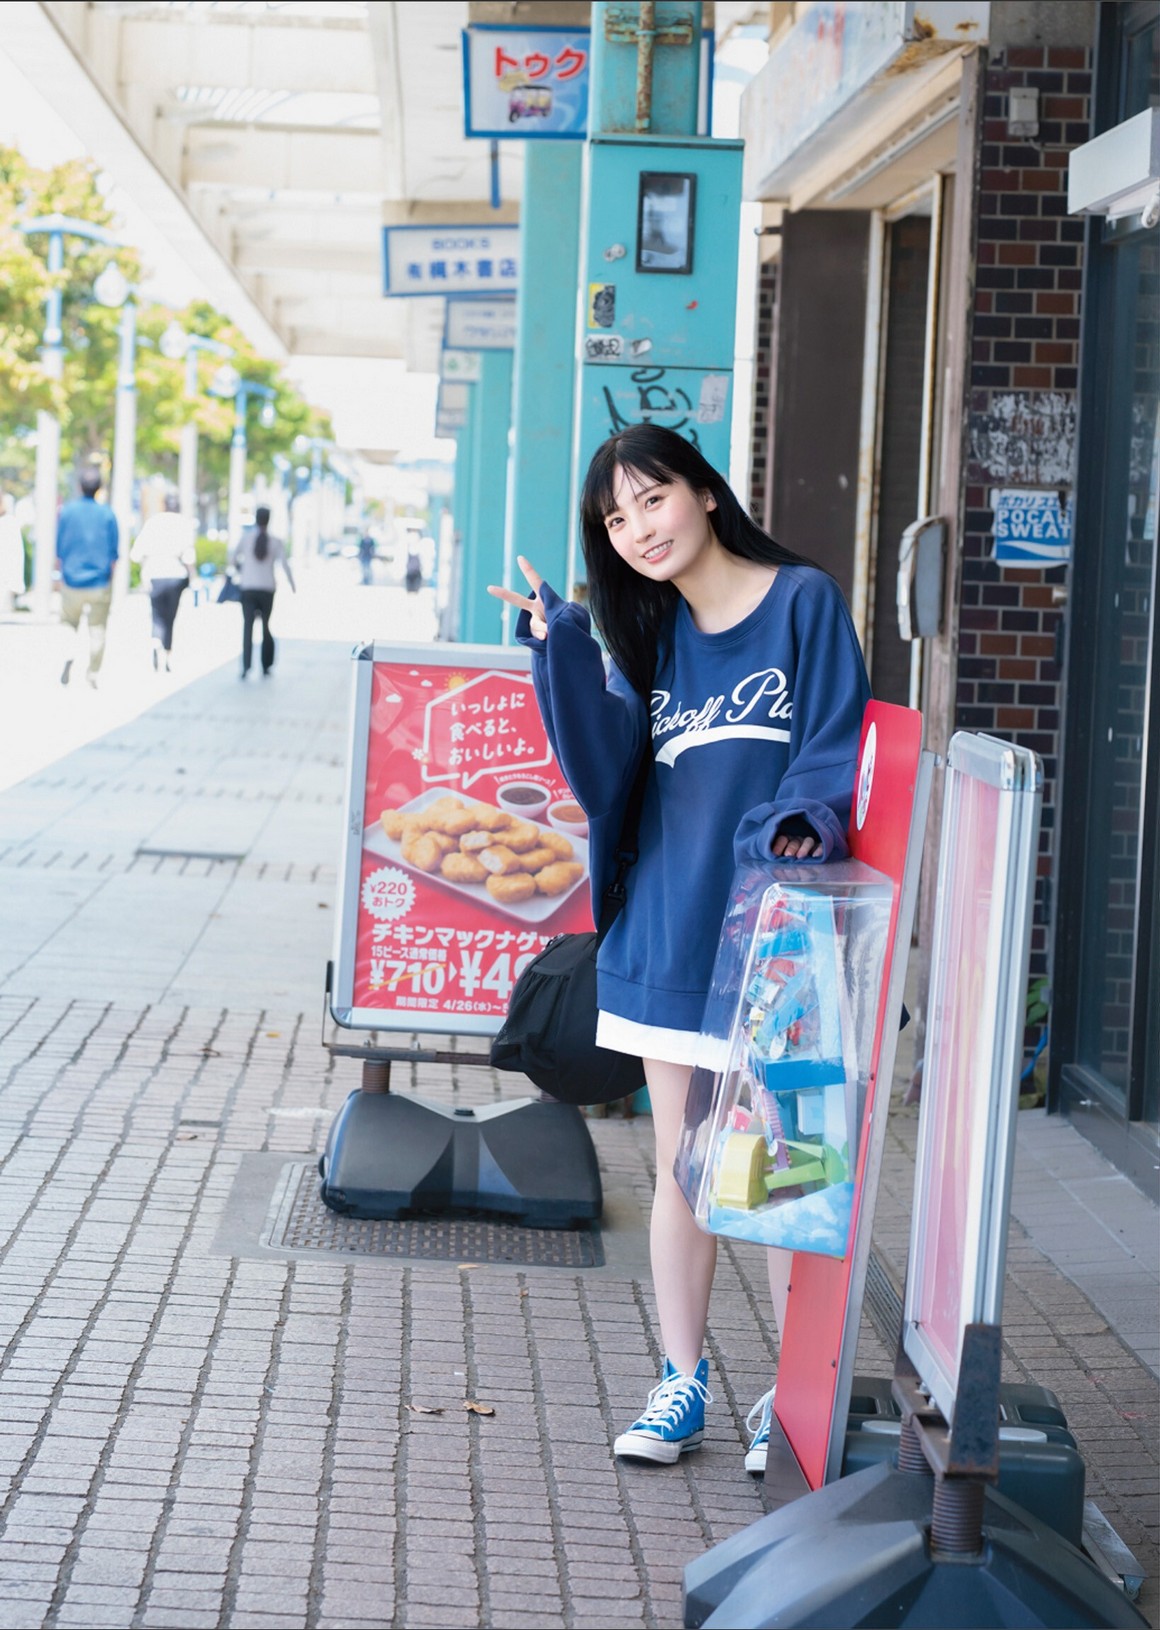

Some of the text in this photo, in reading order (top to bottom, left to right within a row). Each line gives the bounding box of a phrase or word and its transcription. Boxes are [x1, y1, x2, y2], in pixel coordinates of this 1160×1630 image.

[495, 46, 586, 79] トゥク
[997, 522, 1071, 538] SWEAT
[450, 692, 526, 717] いっしょに
[449, 717, 517, 743] 食べると、
[448, 737, 535, 766] おいしいよ。
[372, 896, 406, 908] おトク
